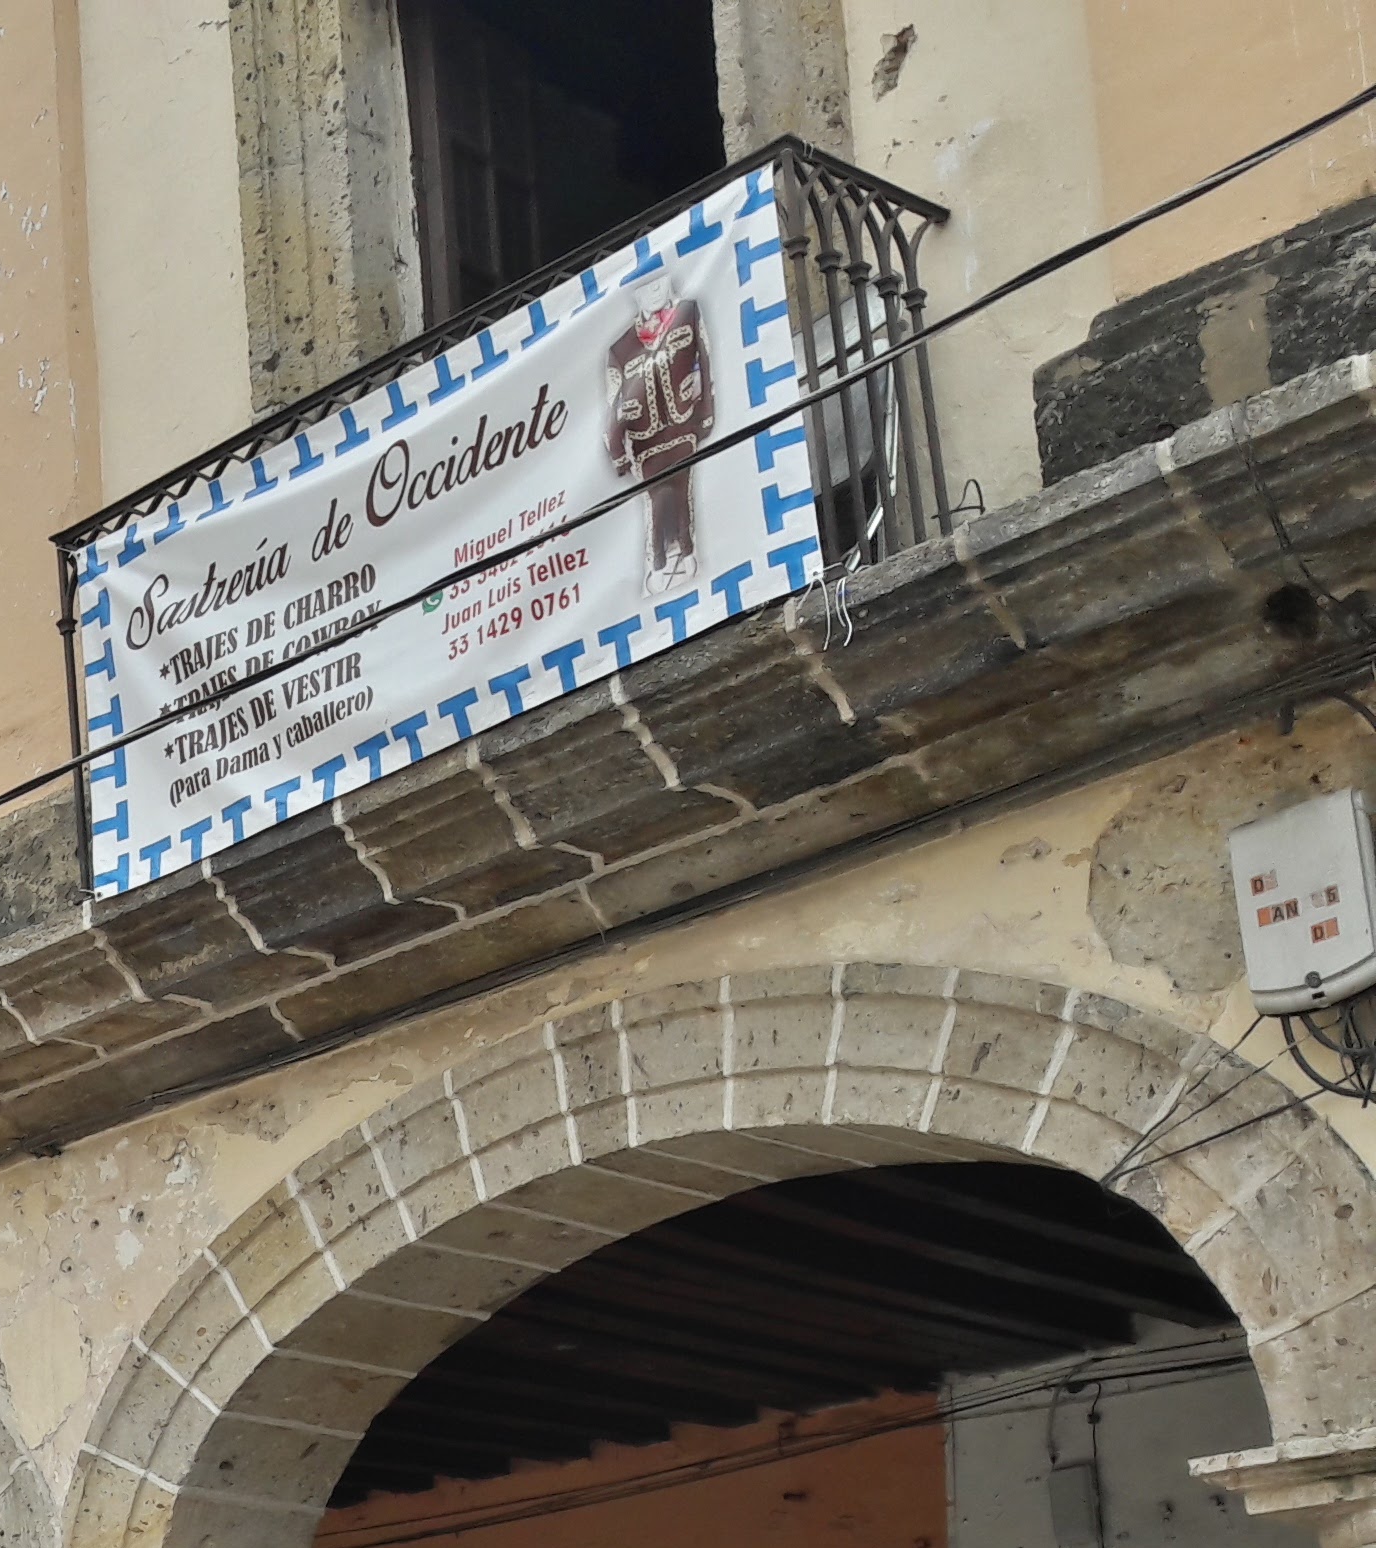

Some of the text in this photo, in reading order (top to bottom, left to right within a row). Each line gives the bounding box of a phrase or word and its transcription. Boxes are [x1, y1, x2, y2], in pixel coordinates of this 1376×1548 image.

[126, 383, 568, 651] Sastrería de Occidente
[454, 518, 512, 568] Miguel
[519, 489, 566, 531] Tellez
[169, 563, 377, 686] TRAJES DE CHARRO
[441, 548, 589, 635] Juan Luis Tellez
[448, 583, 581, 660] 33 1429 0761
[169, 685, 374, 808] (Para Dama y caballero)
[174, 651, 363, 765] TRAJES DE VESTIR
